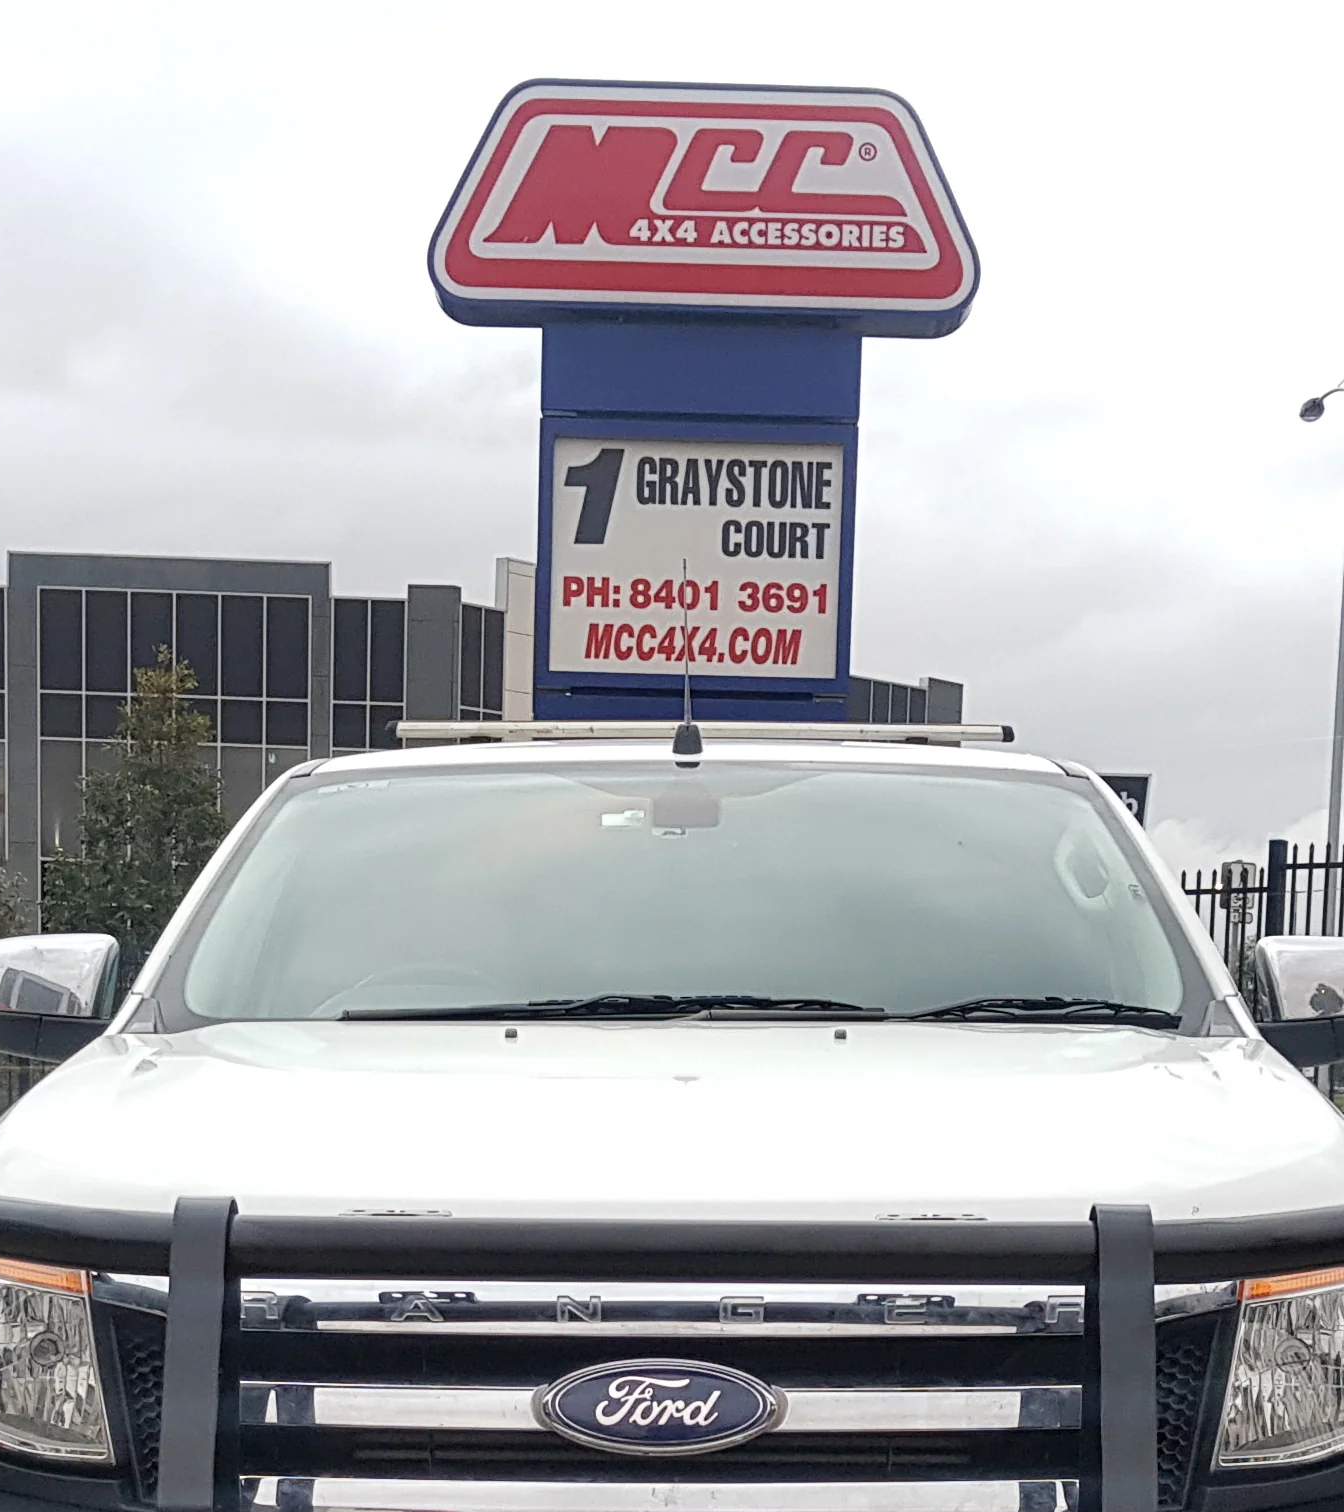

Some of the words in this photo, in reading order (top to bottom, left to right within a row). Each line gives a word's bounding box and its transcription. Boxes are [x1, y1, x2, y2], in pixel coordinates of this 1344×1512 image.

[628, 218, 698, 243] 4X4
[710, 220, 905, 248] ACCESSORIES
[564, 448, 625, 544] 1
[636, 456, 833, 510] GRAYSTONE
[721, 519, 831, 560] COURT
[629, 578, 719, 611] 8401
[737, 581, 828, 614] 3691
[584, 623, 803, 665] MCC4X4.COM
[595, 1375, 722, 1426] Ford
